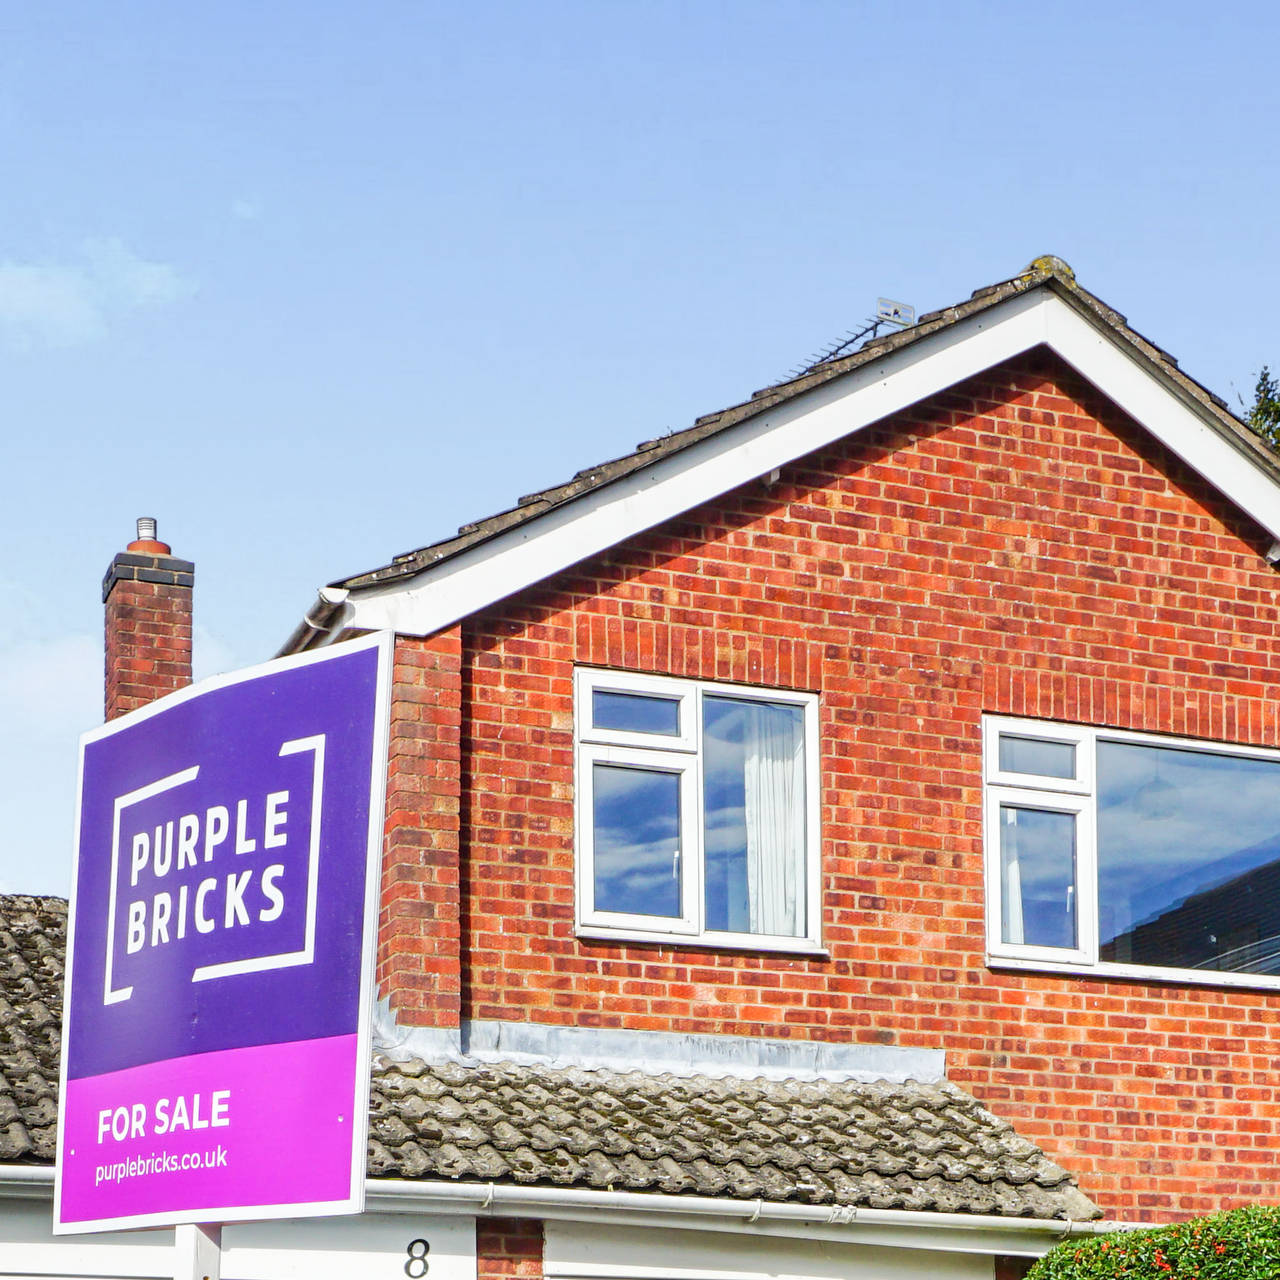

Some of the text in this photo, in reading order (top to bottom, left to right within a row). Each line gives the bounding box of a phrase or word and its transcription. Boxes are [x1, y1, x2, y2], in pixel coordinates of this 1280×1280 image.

[131, 790, 289, 887] PURPLE
[127, 864, 285, 954] BRICKS
[97, 1090, 231, 1144] FOR SALE
[95, 1144, 228, 1187] purplebricks.co.uk
[404, 1238, 430, 1279] 8
